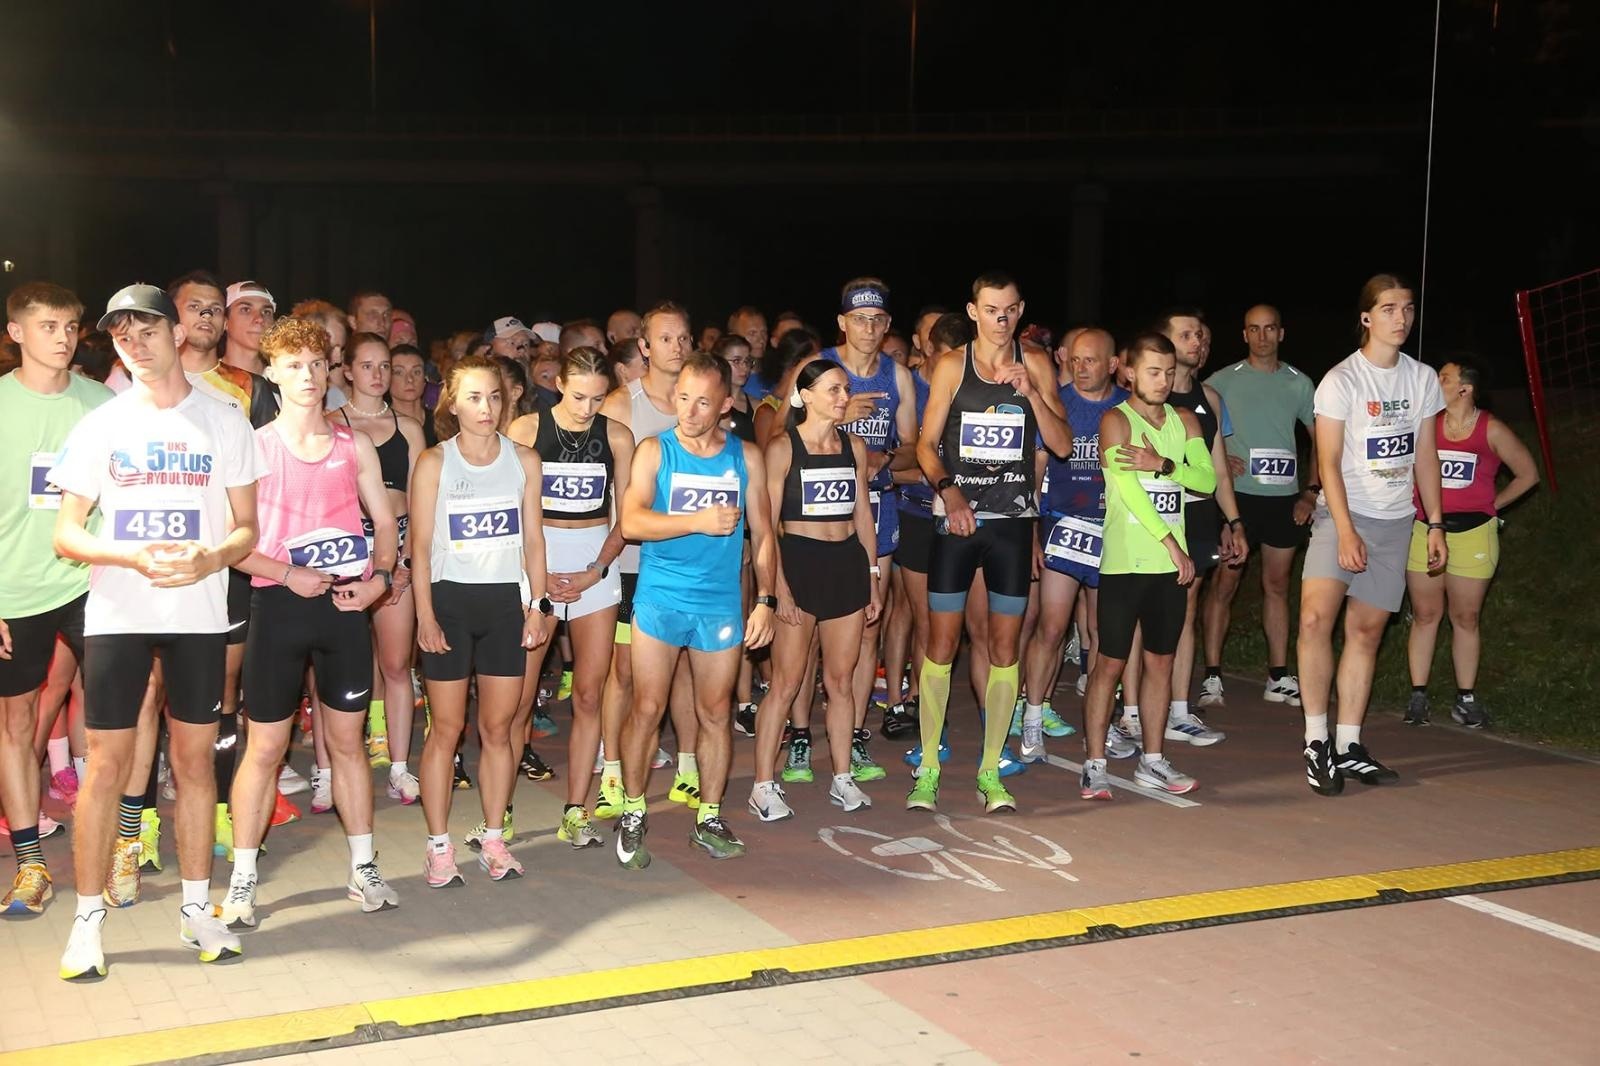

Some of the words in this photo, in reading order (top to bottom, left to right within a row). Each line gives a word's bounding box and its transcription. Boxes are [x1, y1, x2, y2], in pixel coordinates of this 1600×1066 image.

[167, 441, 187, 452] UKS
[871, 437, 886, 446] TEAM
[972, 426, 1014, 447] 359
[1376, 435, 1408, 457] 325
[146, 441, 166, 472] 5
[167, 453, 213, 473] PLUS
[1259, 458, 1290, 475] 217
[550, 476, 595, 498] 455
[813, 480, 850, 502] 262
[953, 473, 1000, 487] RUNNERS
[681, 489, 729, 511] 243
[125, 511, 187, 538] 458
[461, 511, 510, 538] 342
[1058, 528, 1094, 553] 311
[303, 537, 357, 567] 232
